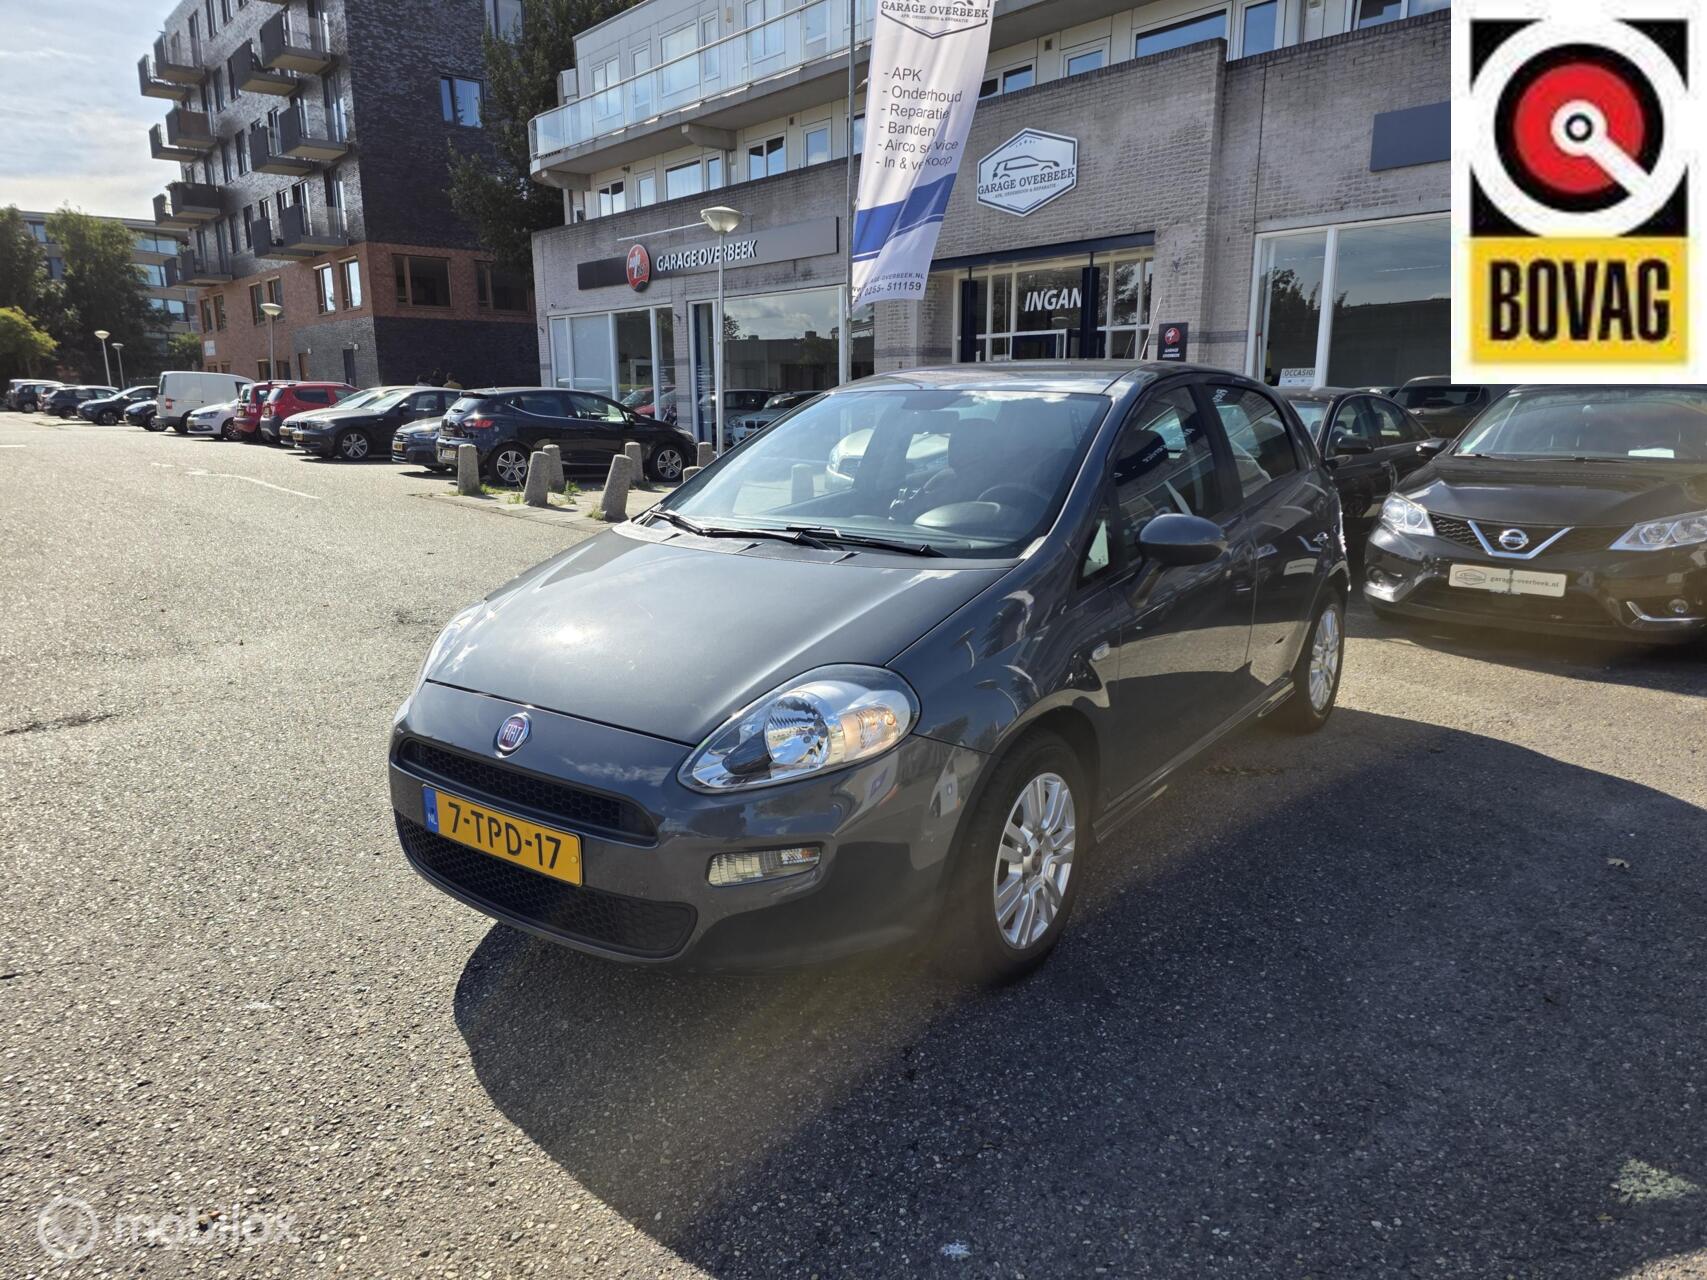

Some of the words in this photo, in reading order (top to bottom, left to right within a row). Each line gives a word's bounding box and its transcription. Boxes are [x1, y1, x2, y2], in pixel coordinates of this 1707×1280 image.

[881, 1, 926, 14] GARAGE
[930, 5, 989, 18] OVERBEEK
[891, 66, 922, 82] APK
[891, 85, 962, 103] Onderhoud
[890, 103, 950, 120] Reparatie
[887, 121, 936, 137] Banden
[885, 139, 916, 153] Airco
[920, 141, 959, 154] svice
[884, 156, 895, 168] In
[900, 157, 907, 169] &
[911, 156, 953, 170] vkoop
[977, 178, 1017, 195] GARAGE
[1019, 167, 1075, 187] OVERBEEK
[656, 249, 699, 272] GARAGE
[698, 240, 757, 266] OVERBEEK
[887, 281, 922, 291] 511159
[1025, 287, 1082, 312] INGAN
[1283, 368, 1315, 377] OCCASIO
[503, 723, 524, 743] FIAT
[427, 812, 437, 825] NL
[448, 801, 562, 870] 7-TPD-17
